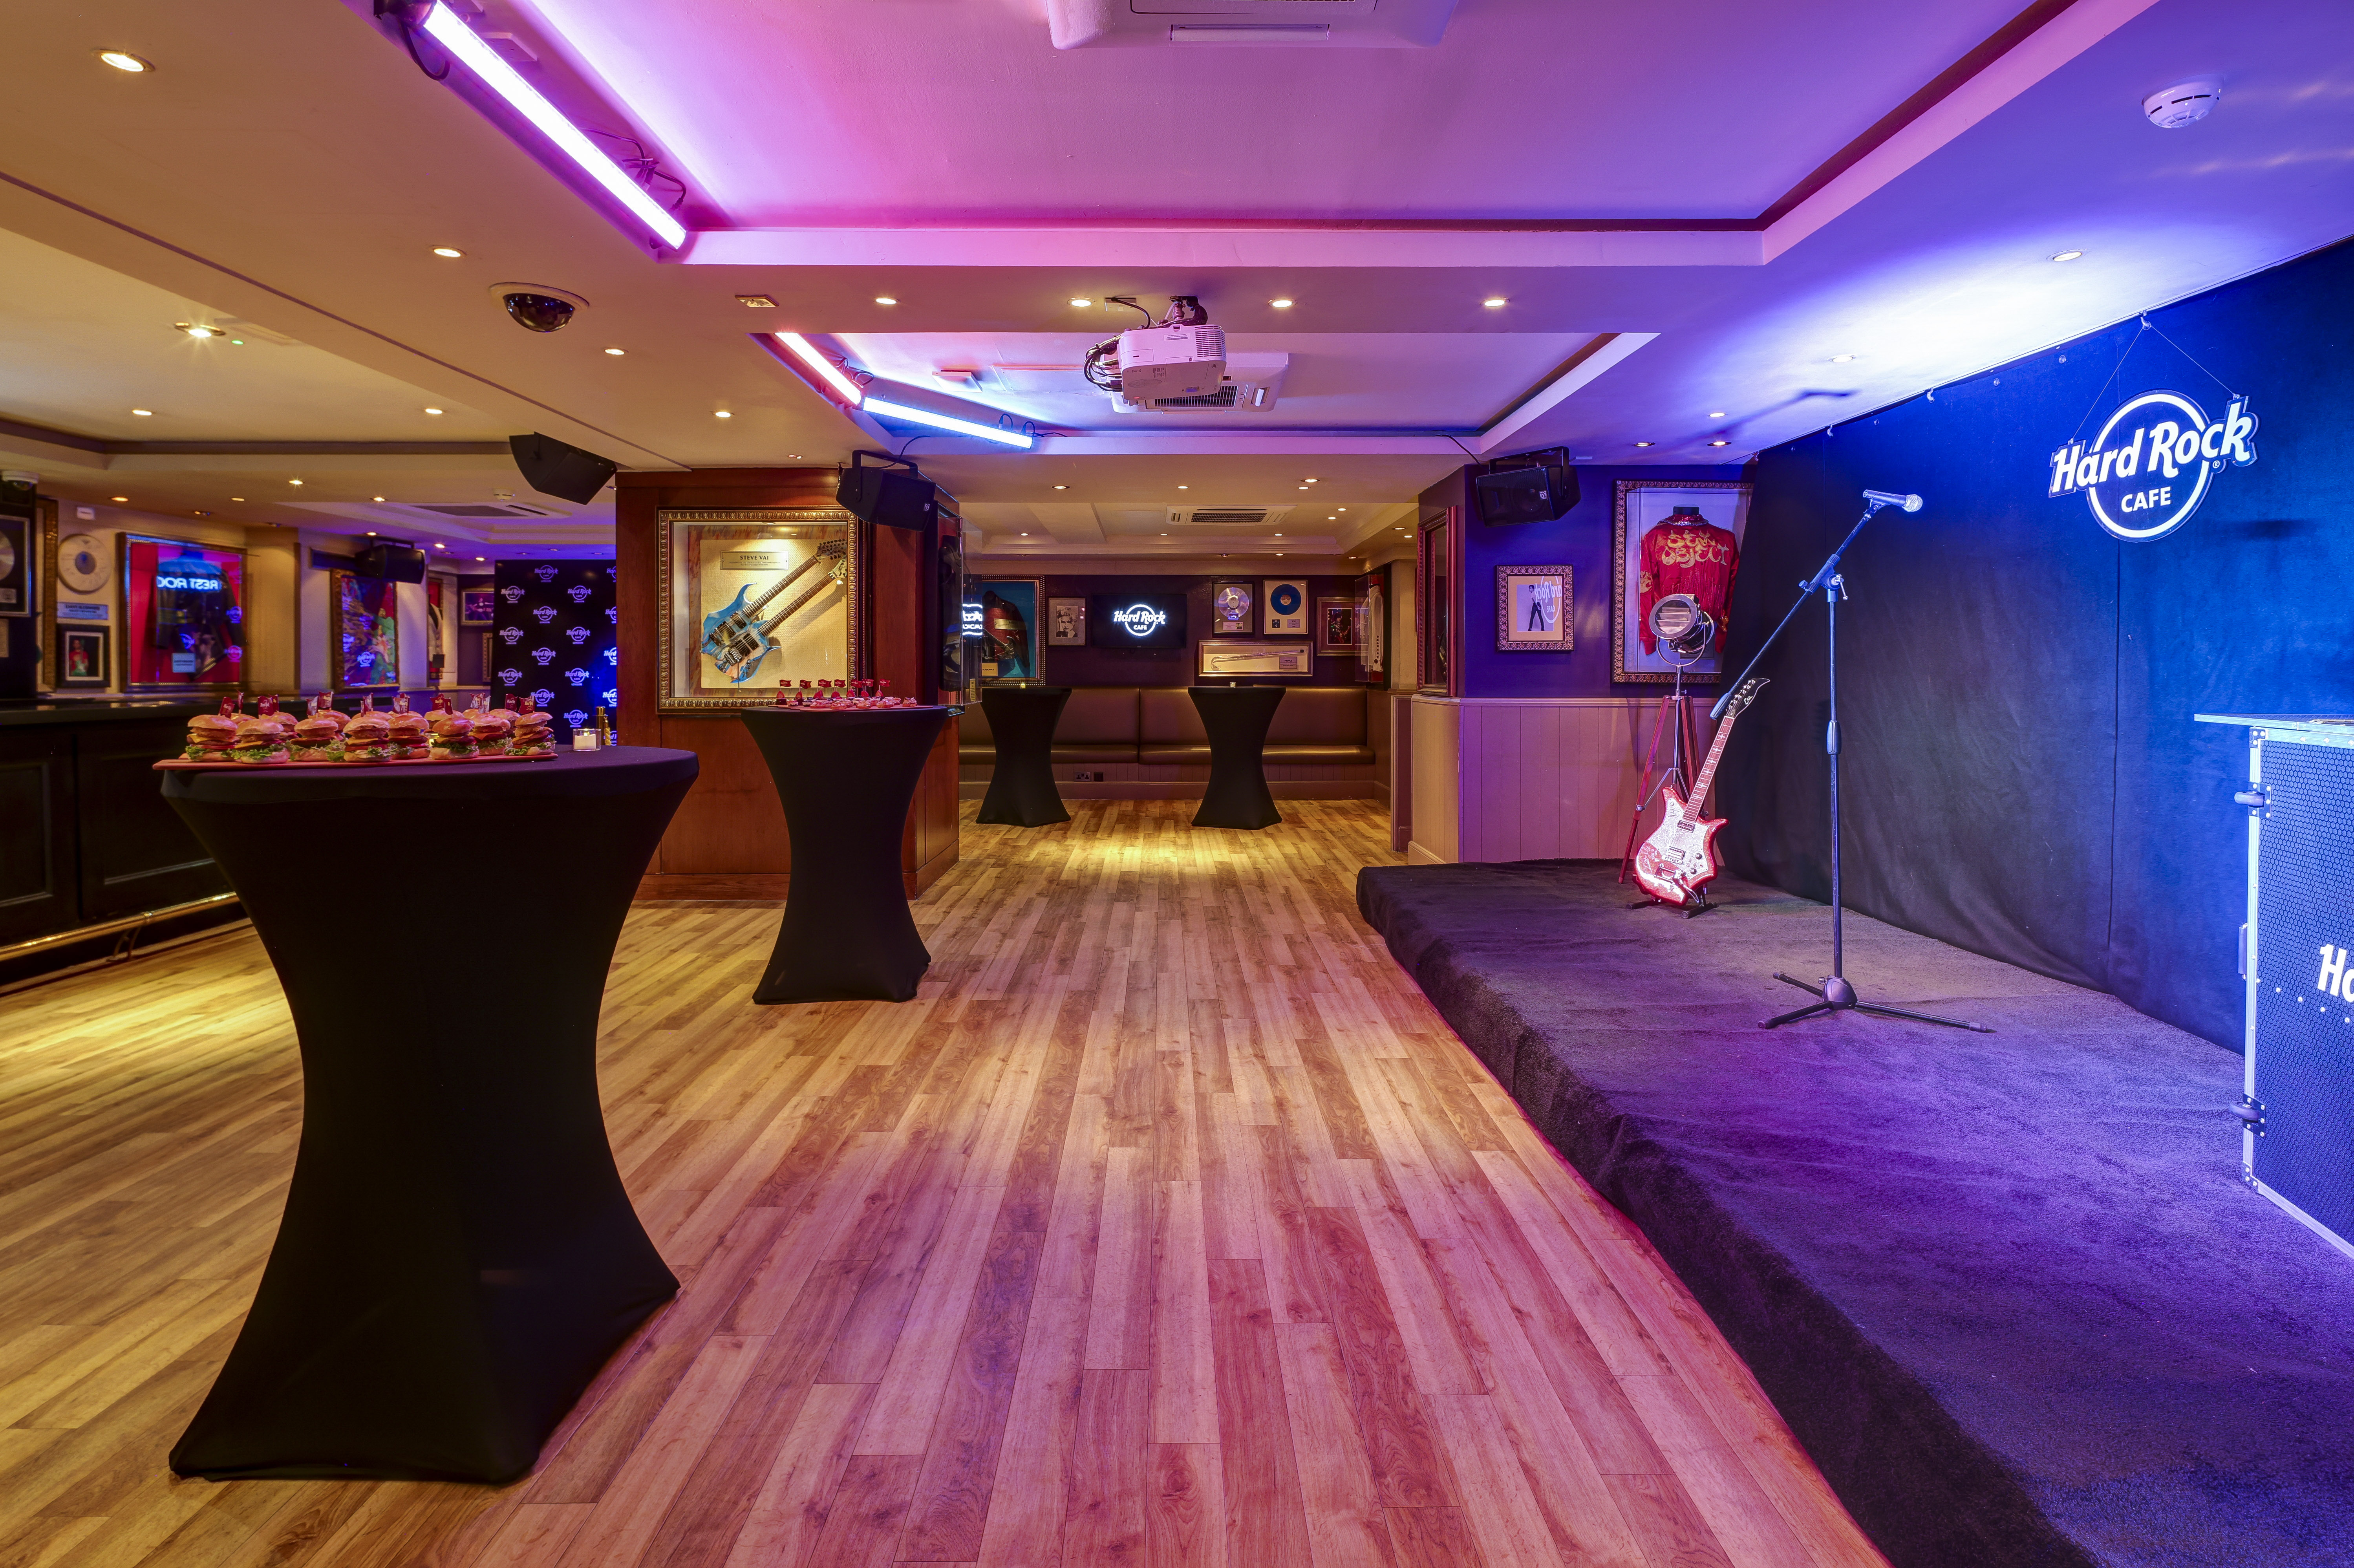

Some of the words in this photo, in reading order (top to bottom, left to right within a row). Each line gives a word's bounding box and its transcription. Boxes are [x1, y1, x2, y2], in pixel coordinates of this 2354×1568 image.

[2052, 428, 2145, 493] Hard
[2147, 402, 2251, 478] Rock
[2121, 487, 2171, 512] CAFE
[1662, 543, 1729, 568] OBJECT
[1114, 611, 1141, 622] Hard
[1140, 611, 1165, 624] Rock
